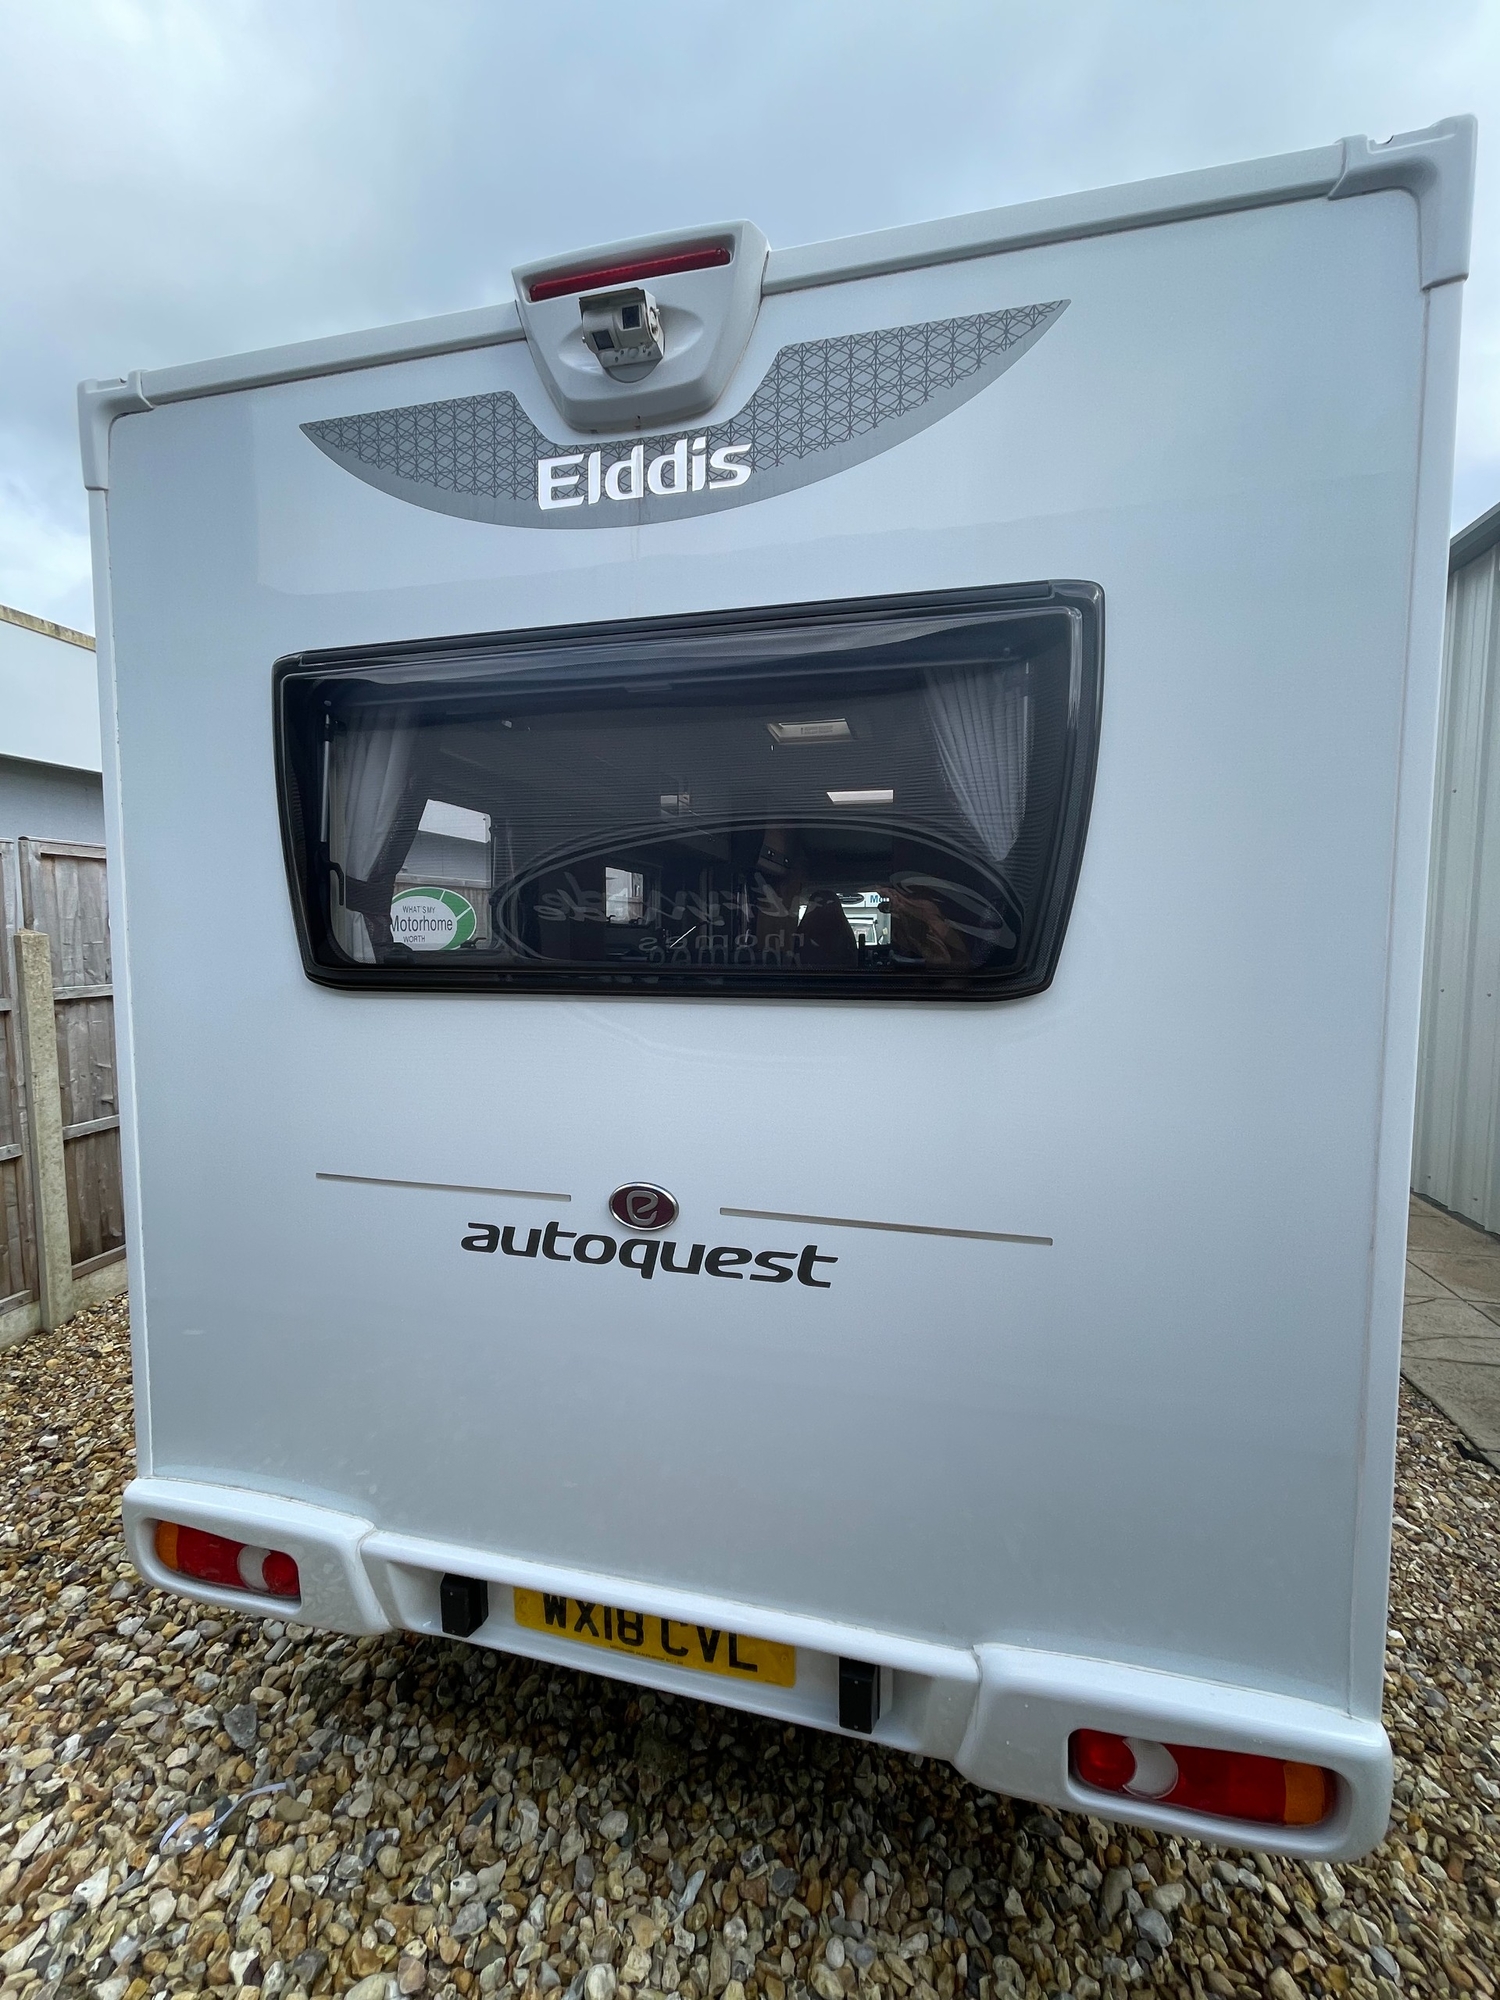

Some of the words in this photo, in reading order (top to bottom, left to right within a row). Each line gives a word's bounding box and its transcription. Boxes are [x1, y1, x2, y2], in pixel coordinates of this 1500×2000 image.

[537, 436, 752, 511] Elddis
[391, 915, 453, 932] Motorhome
[427, 906, 436, 914] MY
[403, 935, 426, 943] WORTH
[460, 1220, 839, 1289] autoquest
[542, 1592, 645, 1648] WX18
[660, 1617, 758, 1673] CVL
